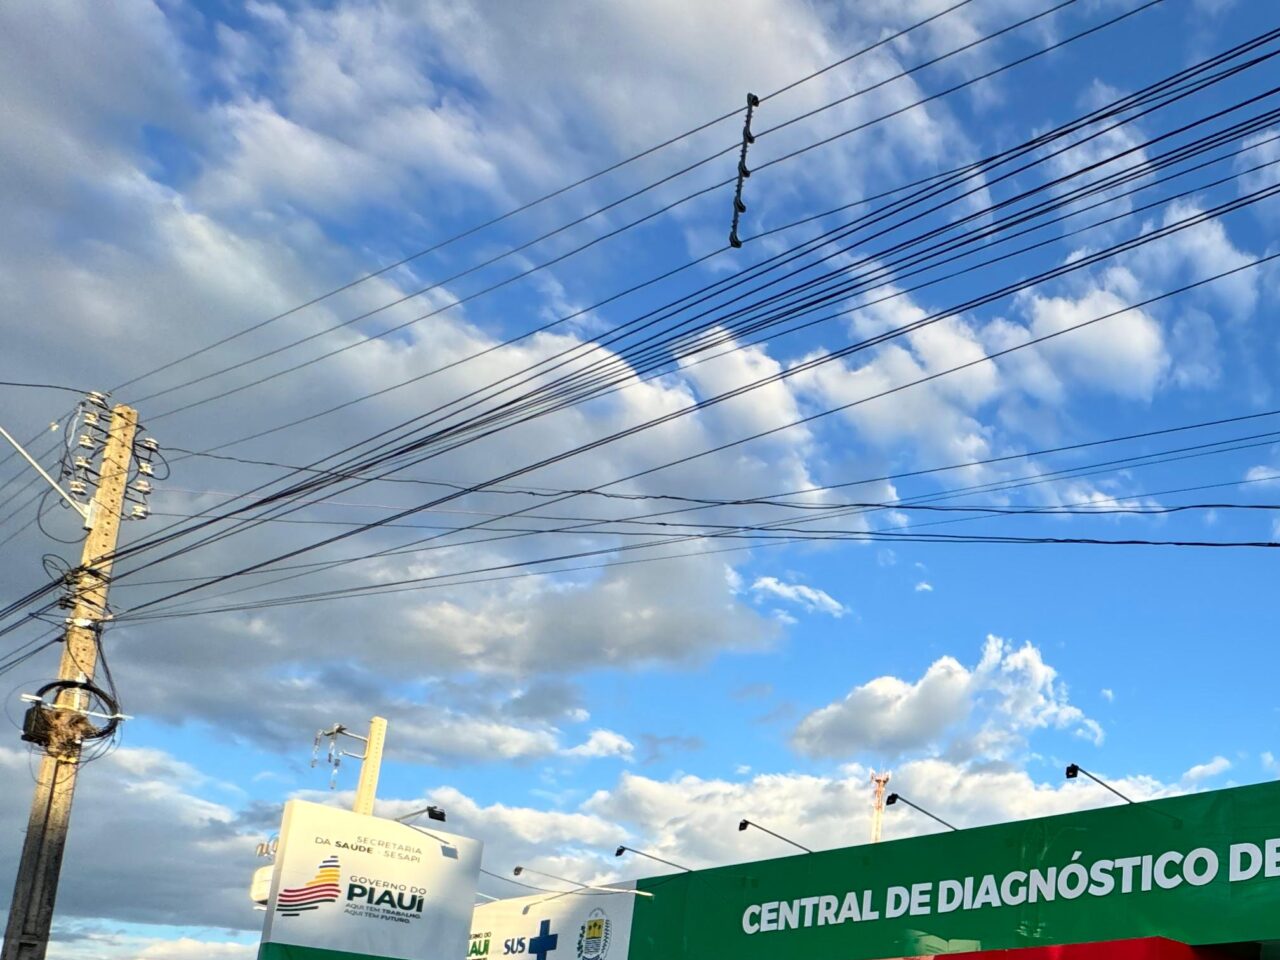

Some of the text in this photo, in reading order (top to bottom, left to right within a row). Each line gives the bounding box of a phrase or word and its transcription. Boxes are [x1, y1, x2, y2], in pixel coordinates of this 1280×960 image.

[314, 836, 331, 846] DA
[383, 850, 421, 863] SESAPI
[356, 836, 423, 854] SECRETARIA
[350, 876, 427, 895] GOVERNO DO
[742, 889, 879, 935] CENTRAL
[885, 882, 931, 918] DE
[937, 850, 1219, 913] DIAGNÓSTICO
[347, 883, 424, 912] PIAUÍ
[344, 908, 363, 917] AQUI
[365, 911, 379, 919] TEM
[503, 937, 526, 955] SUS
